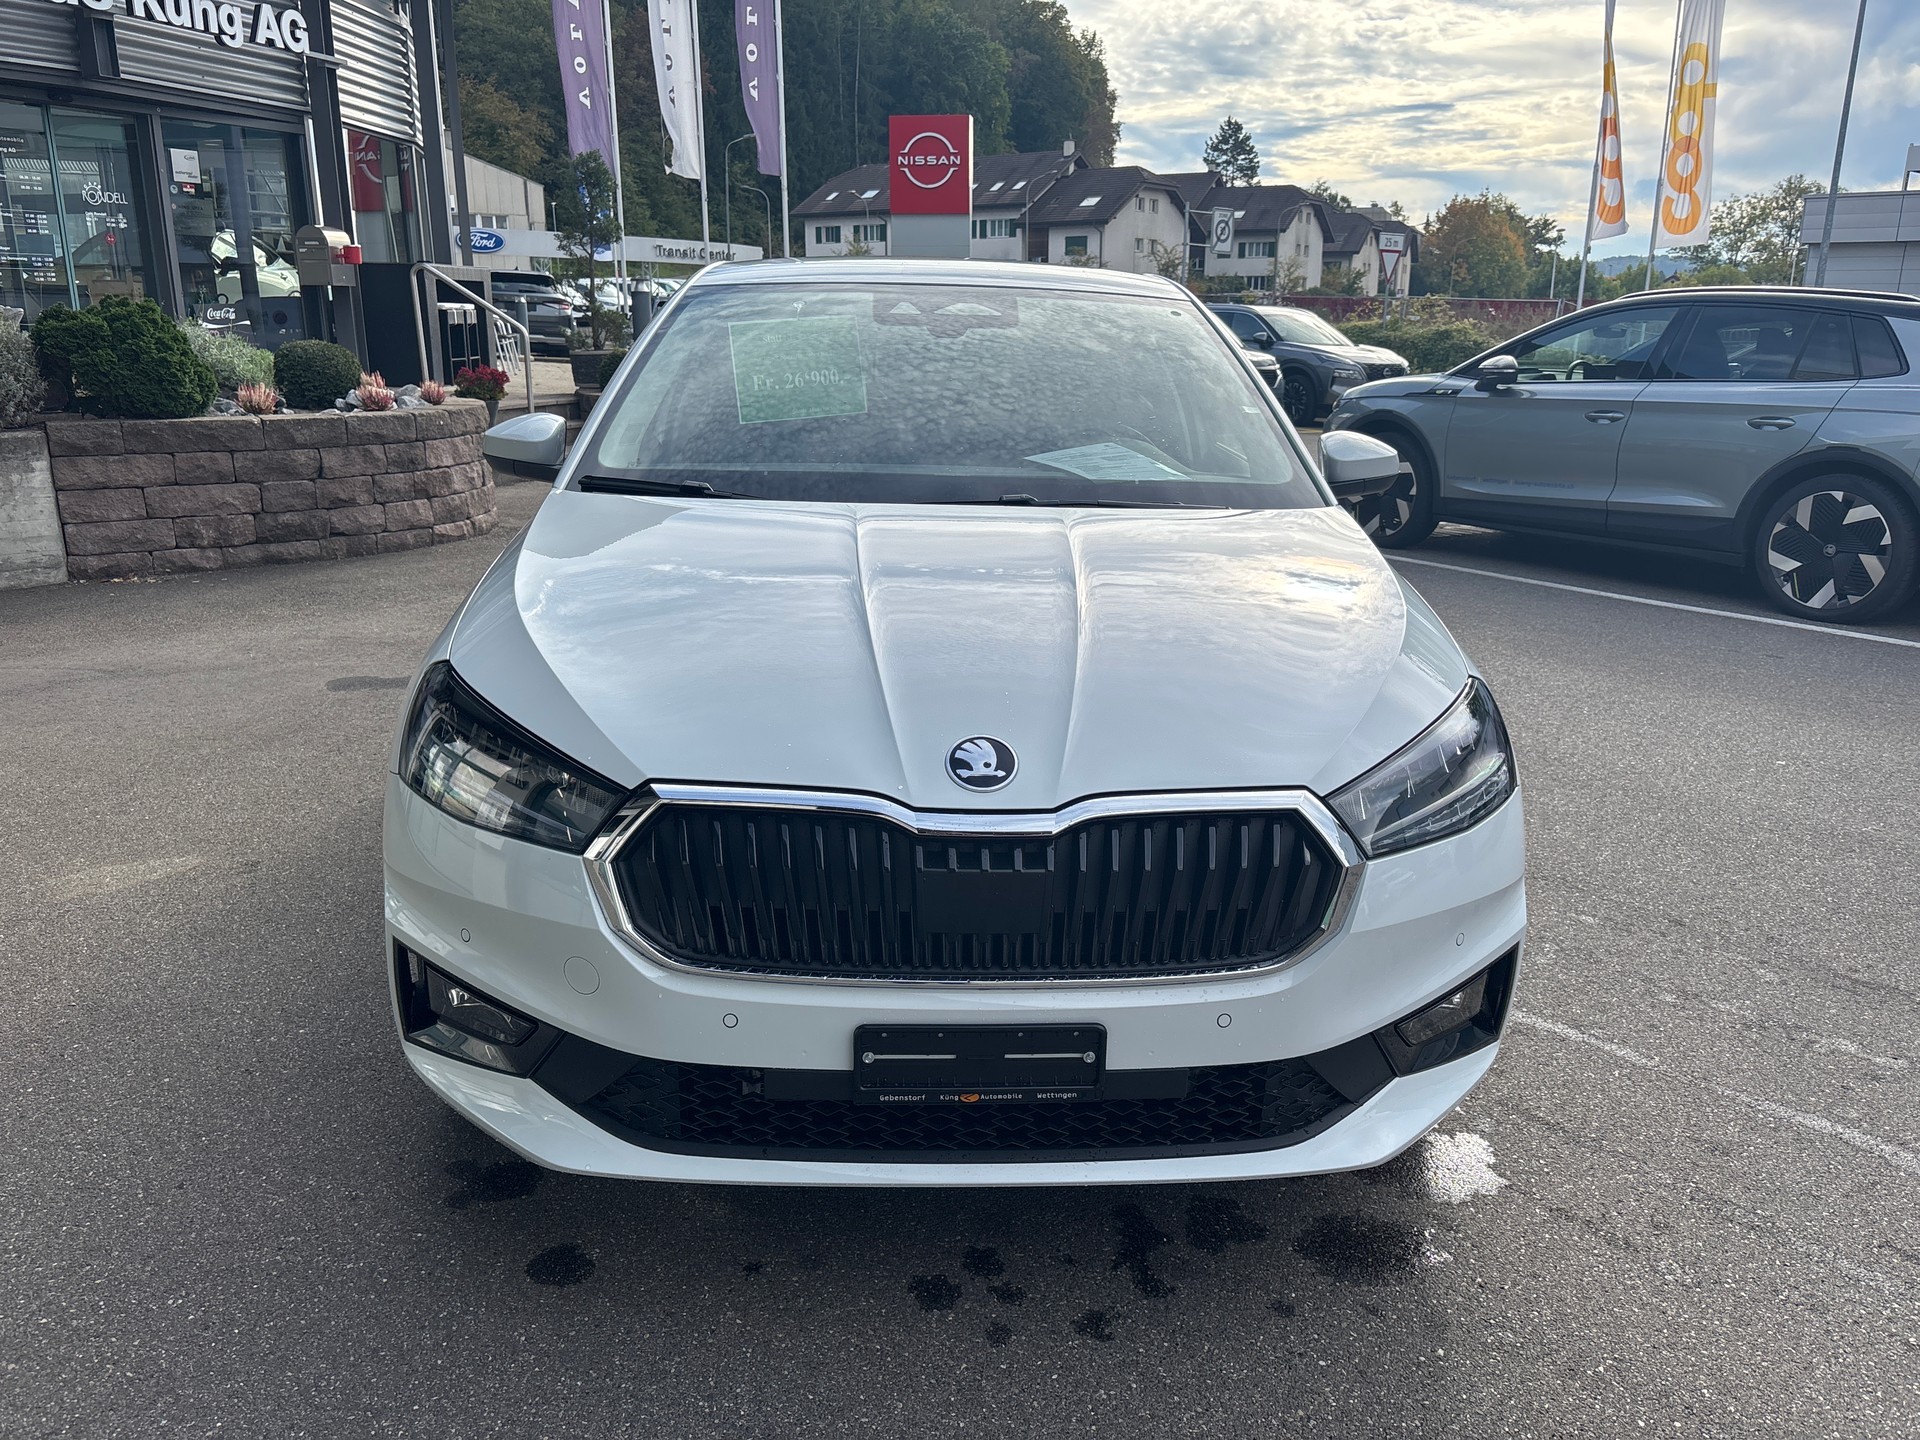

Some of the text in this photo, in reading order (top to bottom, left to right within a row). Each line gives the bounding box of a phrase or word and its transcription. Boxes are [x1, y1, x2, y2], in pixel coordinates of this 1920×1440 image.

[255, 3, 310, 54] AG
[1661, 42, 1717, 235] coop
[897, 155, 961, 165] NISSAN
[82, 190, 128, 205] RONDELL
[470, 232, 497, 248] Ford
[1384, 237, 1393, 248] 25
[655, 244, 737, 261] Transit Center
[752, 374, 780, 391] Fr.
[879, 1092, 1078, 1102] Gebenstorf Küng Automobile Wettingen
